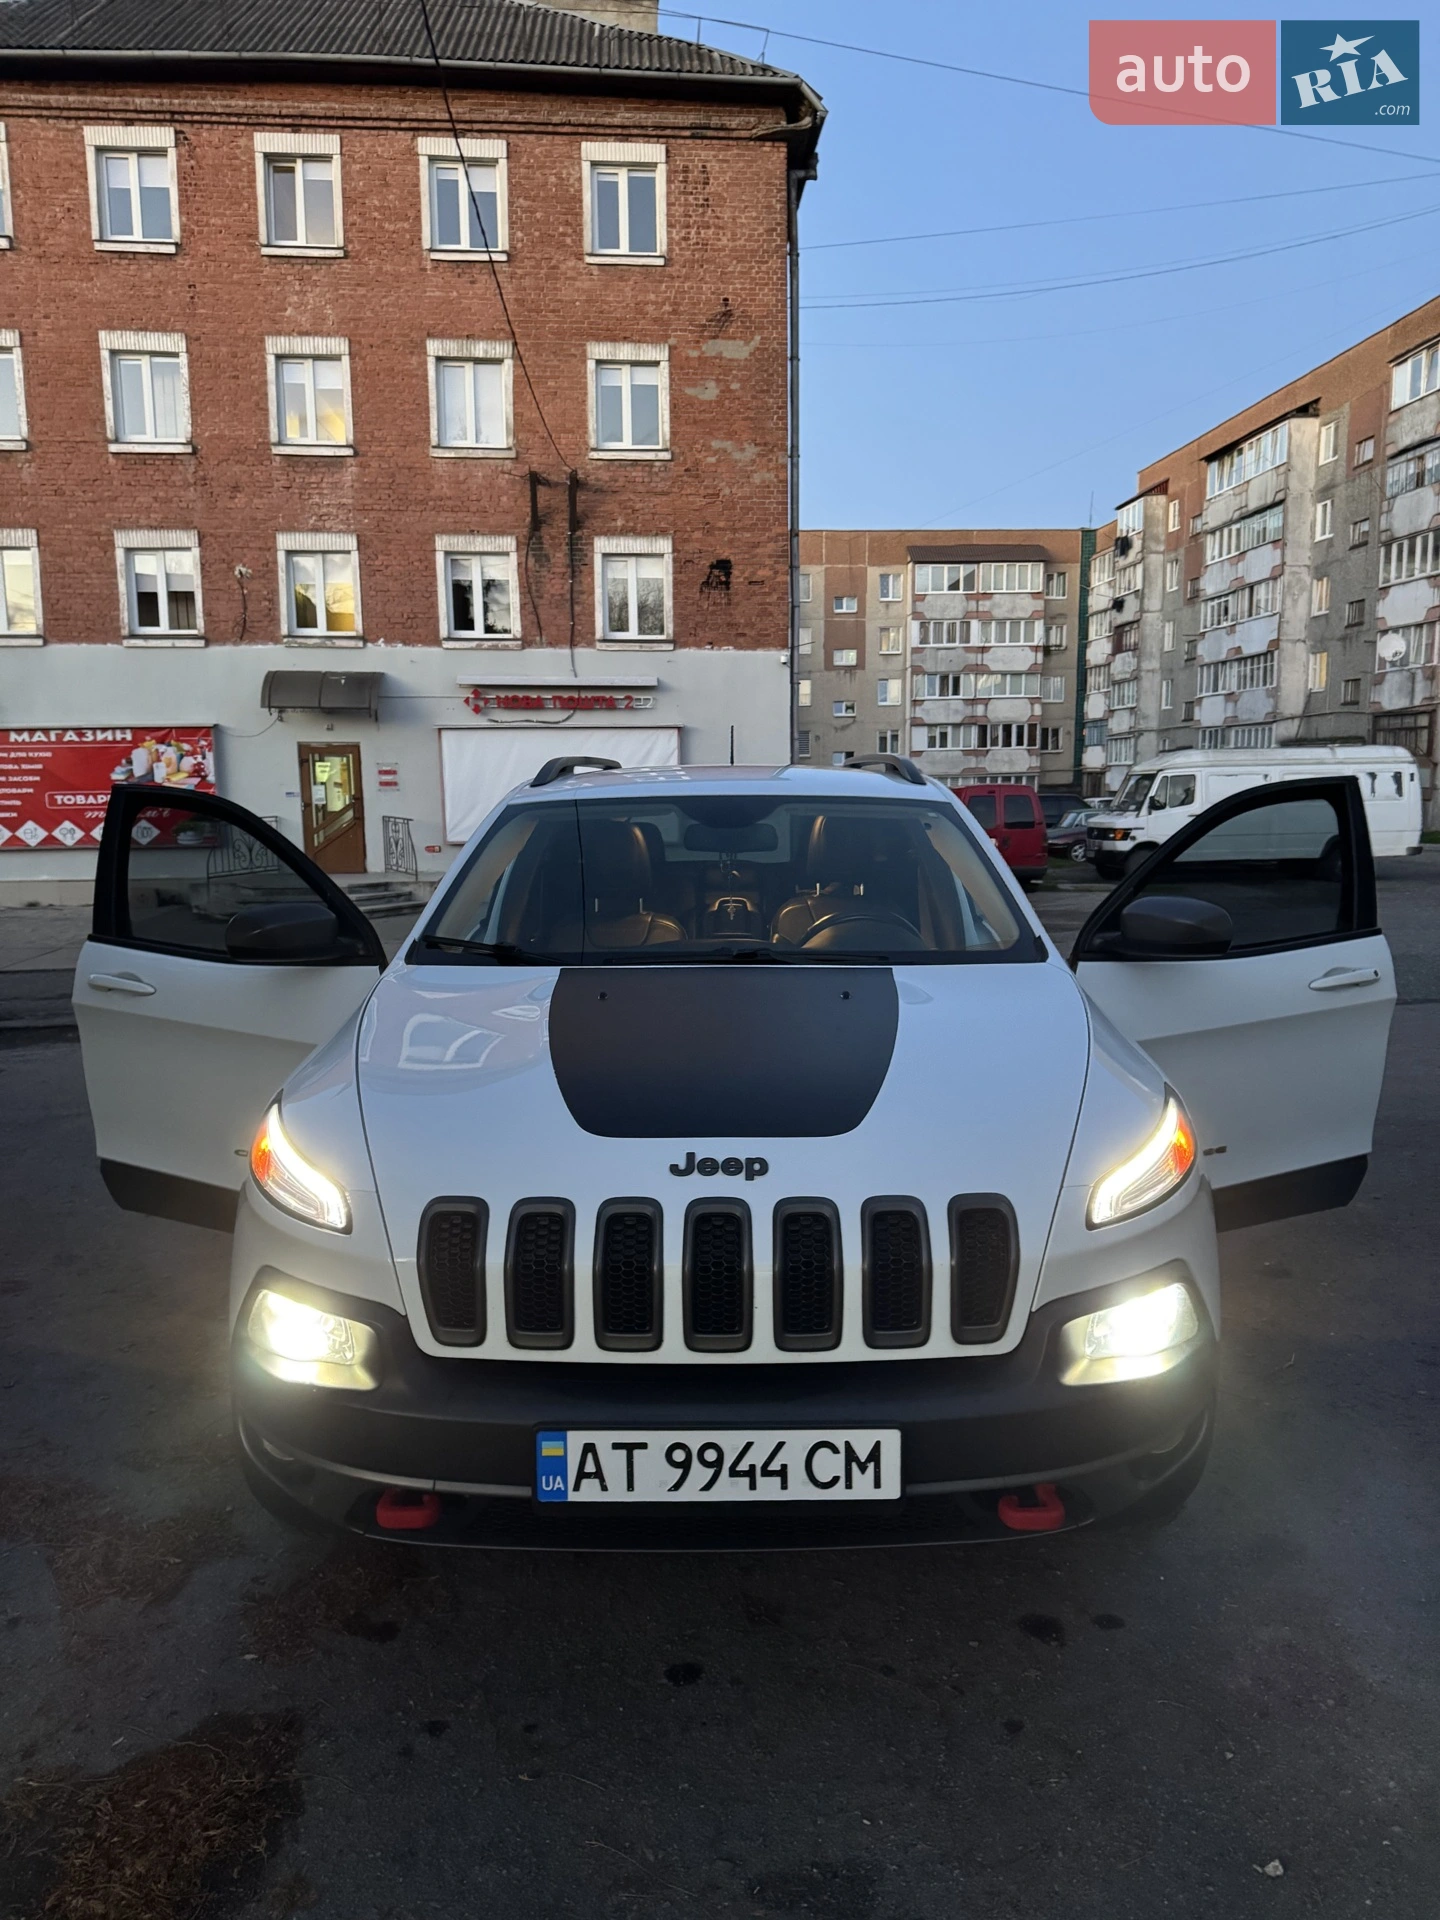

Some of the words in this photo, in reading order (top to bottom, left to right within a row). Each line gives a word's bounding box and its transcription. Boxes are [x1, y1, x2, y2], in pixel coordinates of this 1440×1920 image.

[9, 729, 132, 742] МАГАЗИН
[669, 1152, 769, 1181] Jeep
[572, 1442, 649, 1492] AT
[664, 1441, 788, 1492] 9944
[804, 1440, 882, 1490] CM
[542, 1475, 565, 1491] UA
